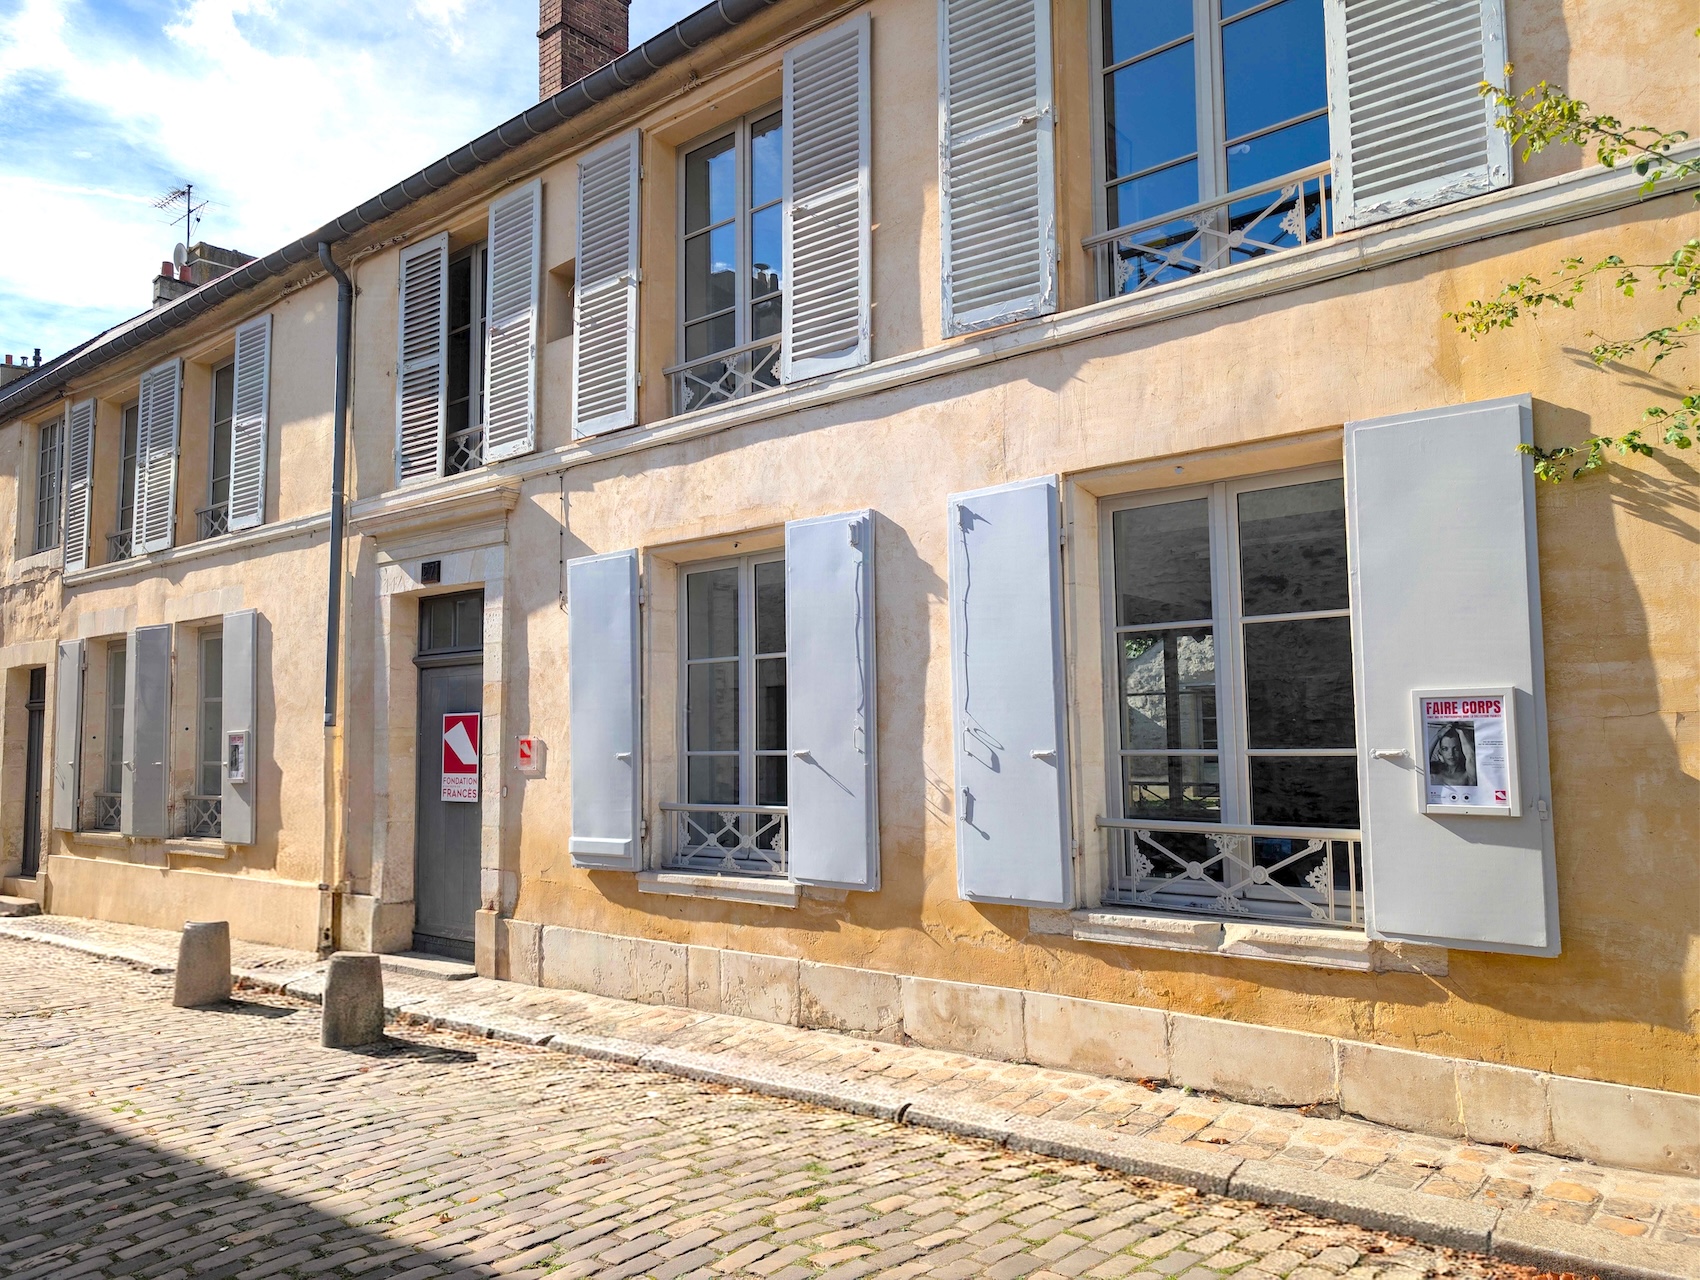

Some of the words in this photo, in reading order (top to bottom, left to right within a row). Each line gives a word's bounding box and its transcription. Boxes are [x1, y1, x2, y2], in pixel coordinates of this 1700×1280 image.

[1426, 702, 1458, 714] FAIRE
[1462, 700, 1501, 714] CORPS
[443, 777, 477, 785] FONDATION
